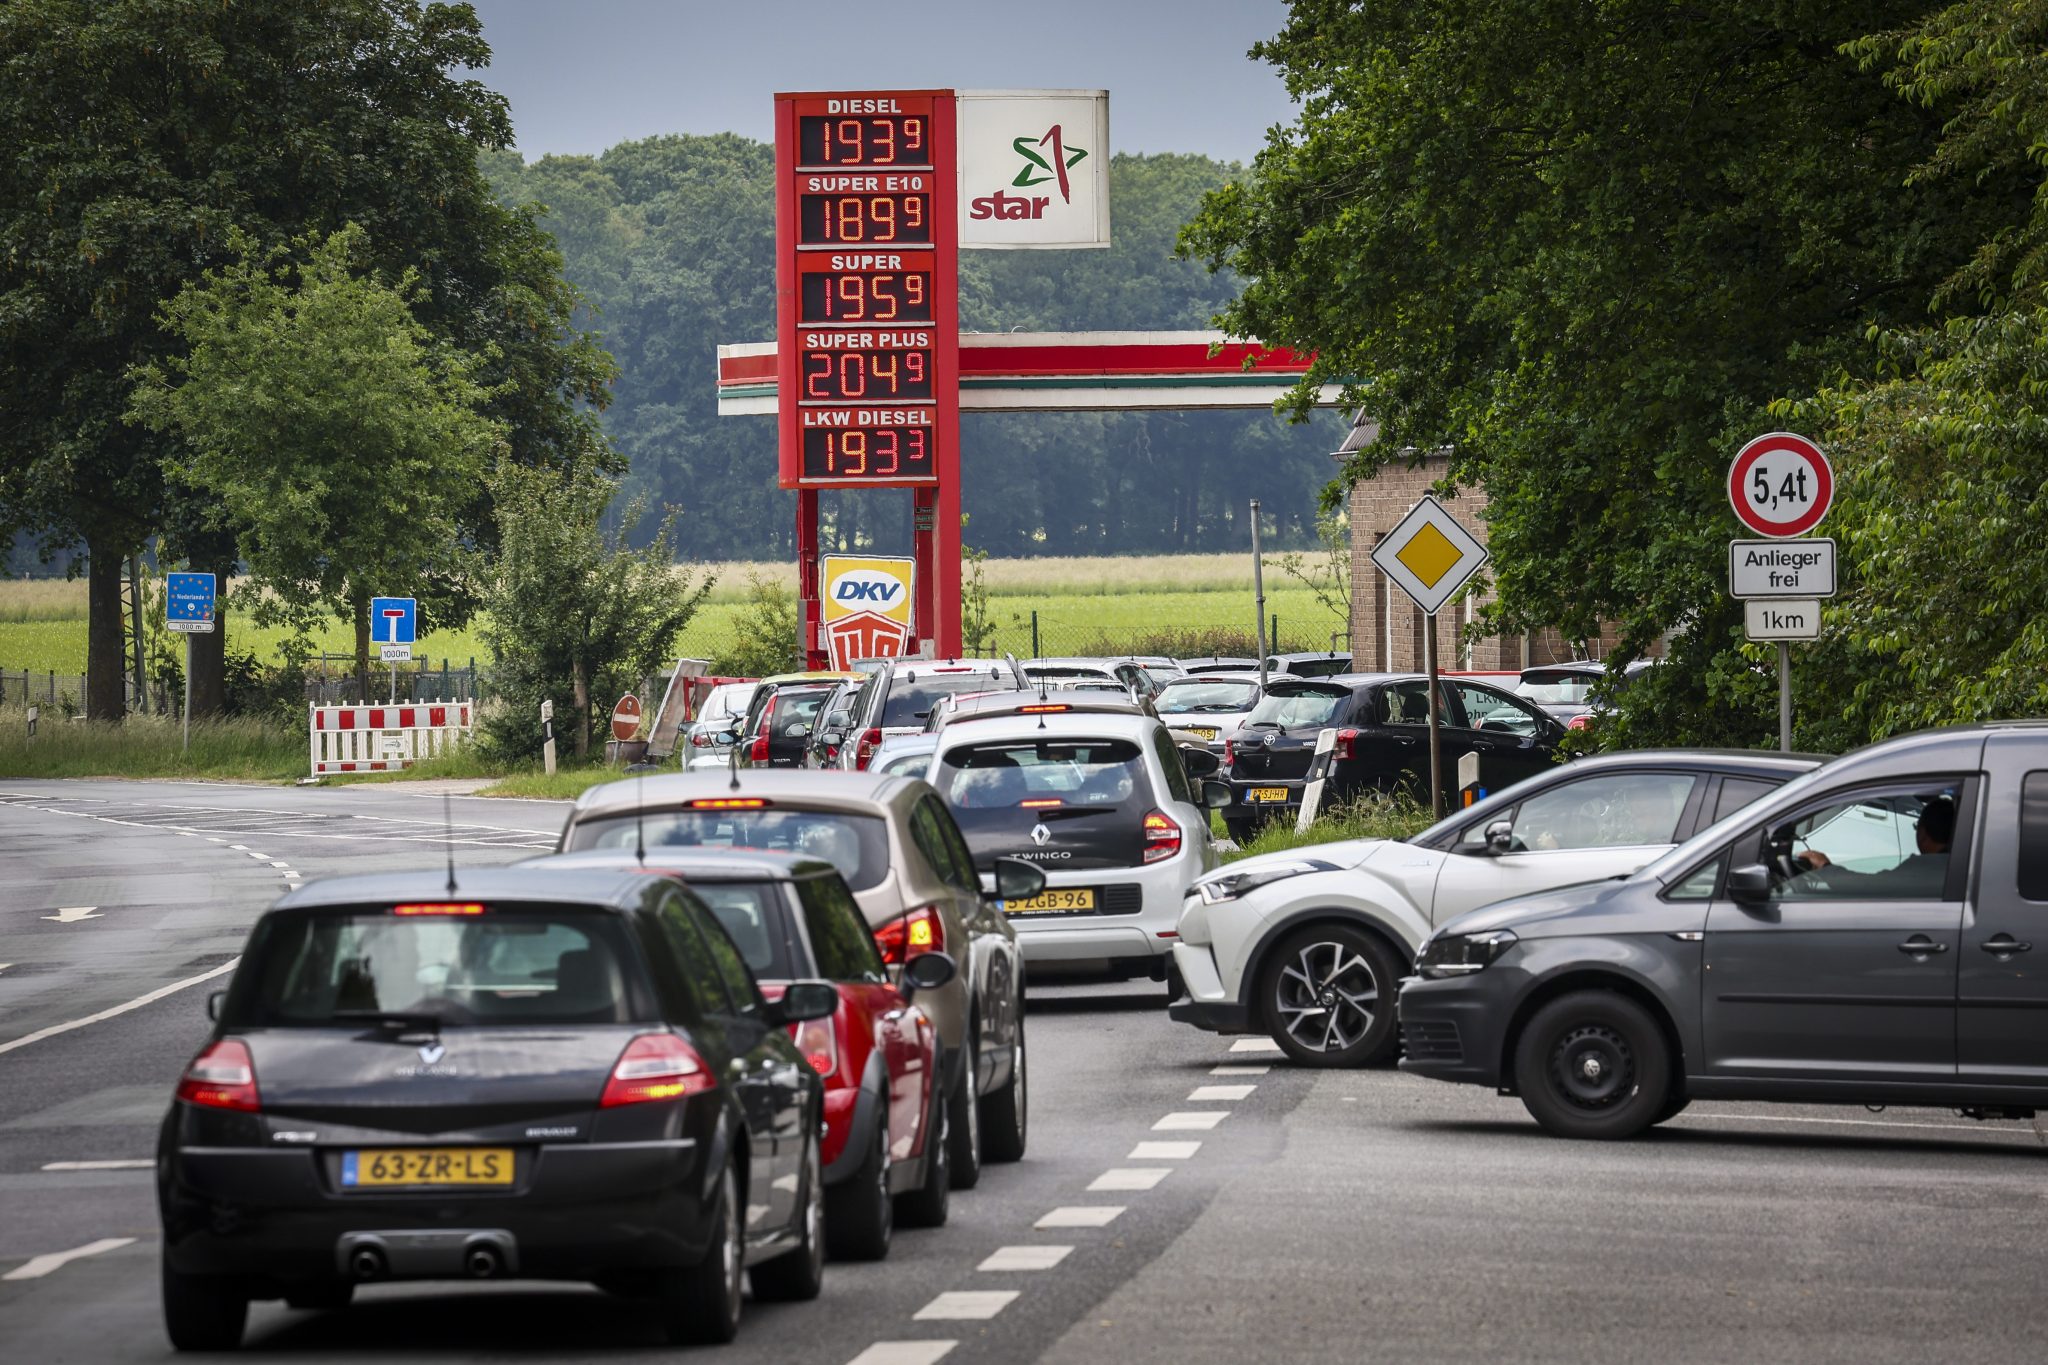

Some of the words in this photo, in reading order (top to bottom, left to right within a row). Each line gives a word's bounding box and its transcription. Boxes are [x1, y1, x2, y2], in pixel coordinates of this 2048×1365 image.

[827, 99, 902, 114] DIESEL
[808, 176, 879, 192] SUPER
[886, 176, 922, 191] E10
[969, 190, 1050, 220] star
[831, 255, 902, 270] SUPER
[806, 333, 874, 348] SUPER
[879, 332, 929, 347] PLUS
[804, 411, 851, 426] LKW
[858, 410, 932, 426] DIESEL
[1753, 466, 1808, 511] 5,4t
[1745, 550, 1822, 570] Anlieger
[1769, 571, 1800, 588] frei
[836, 581, 901, 601] DKV
[1010, 851, 1072, 861] TWINGO
[371, 1154, 499, 1180] 63-ZR-LS
